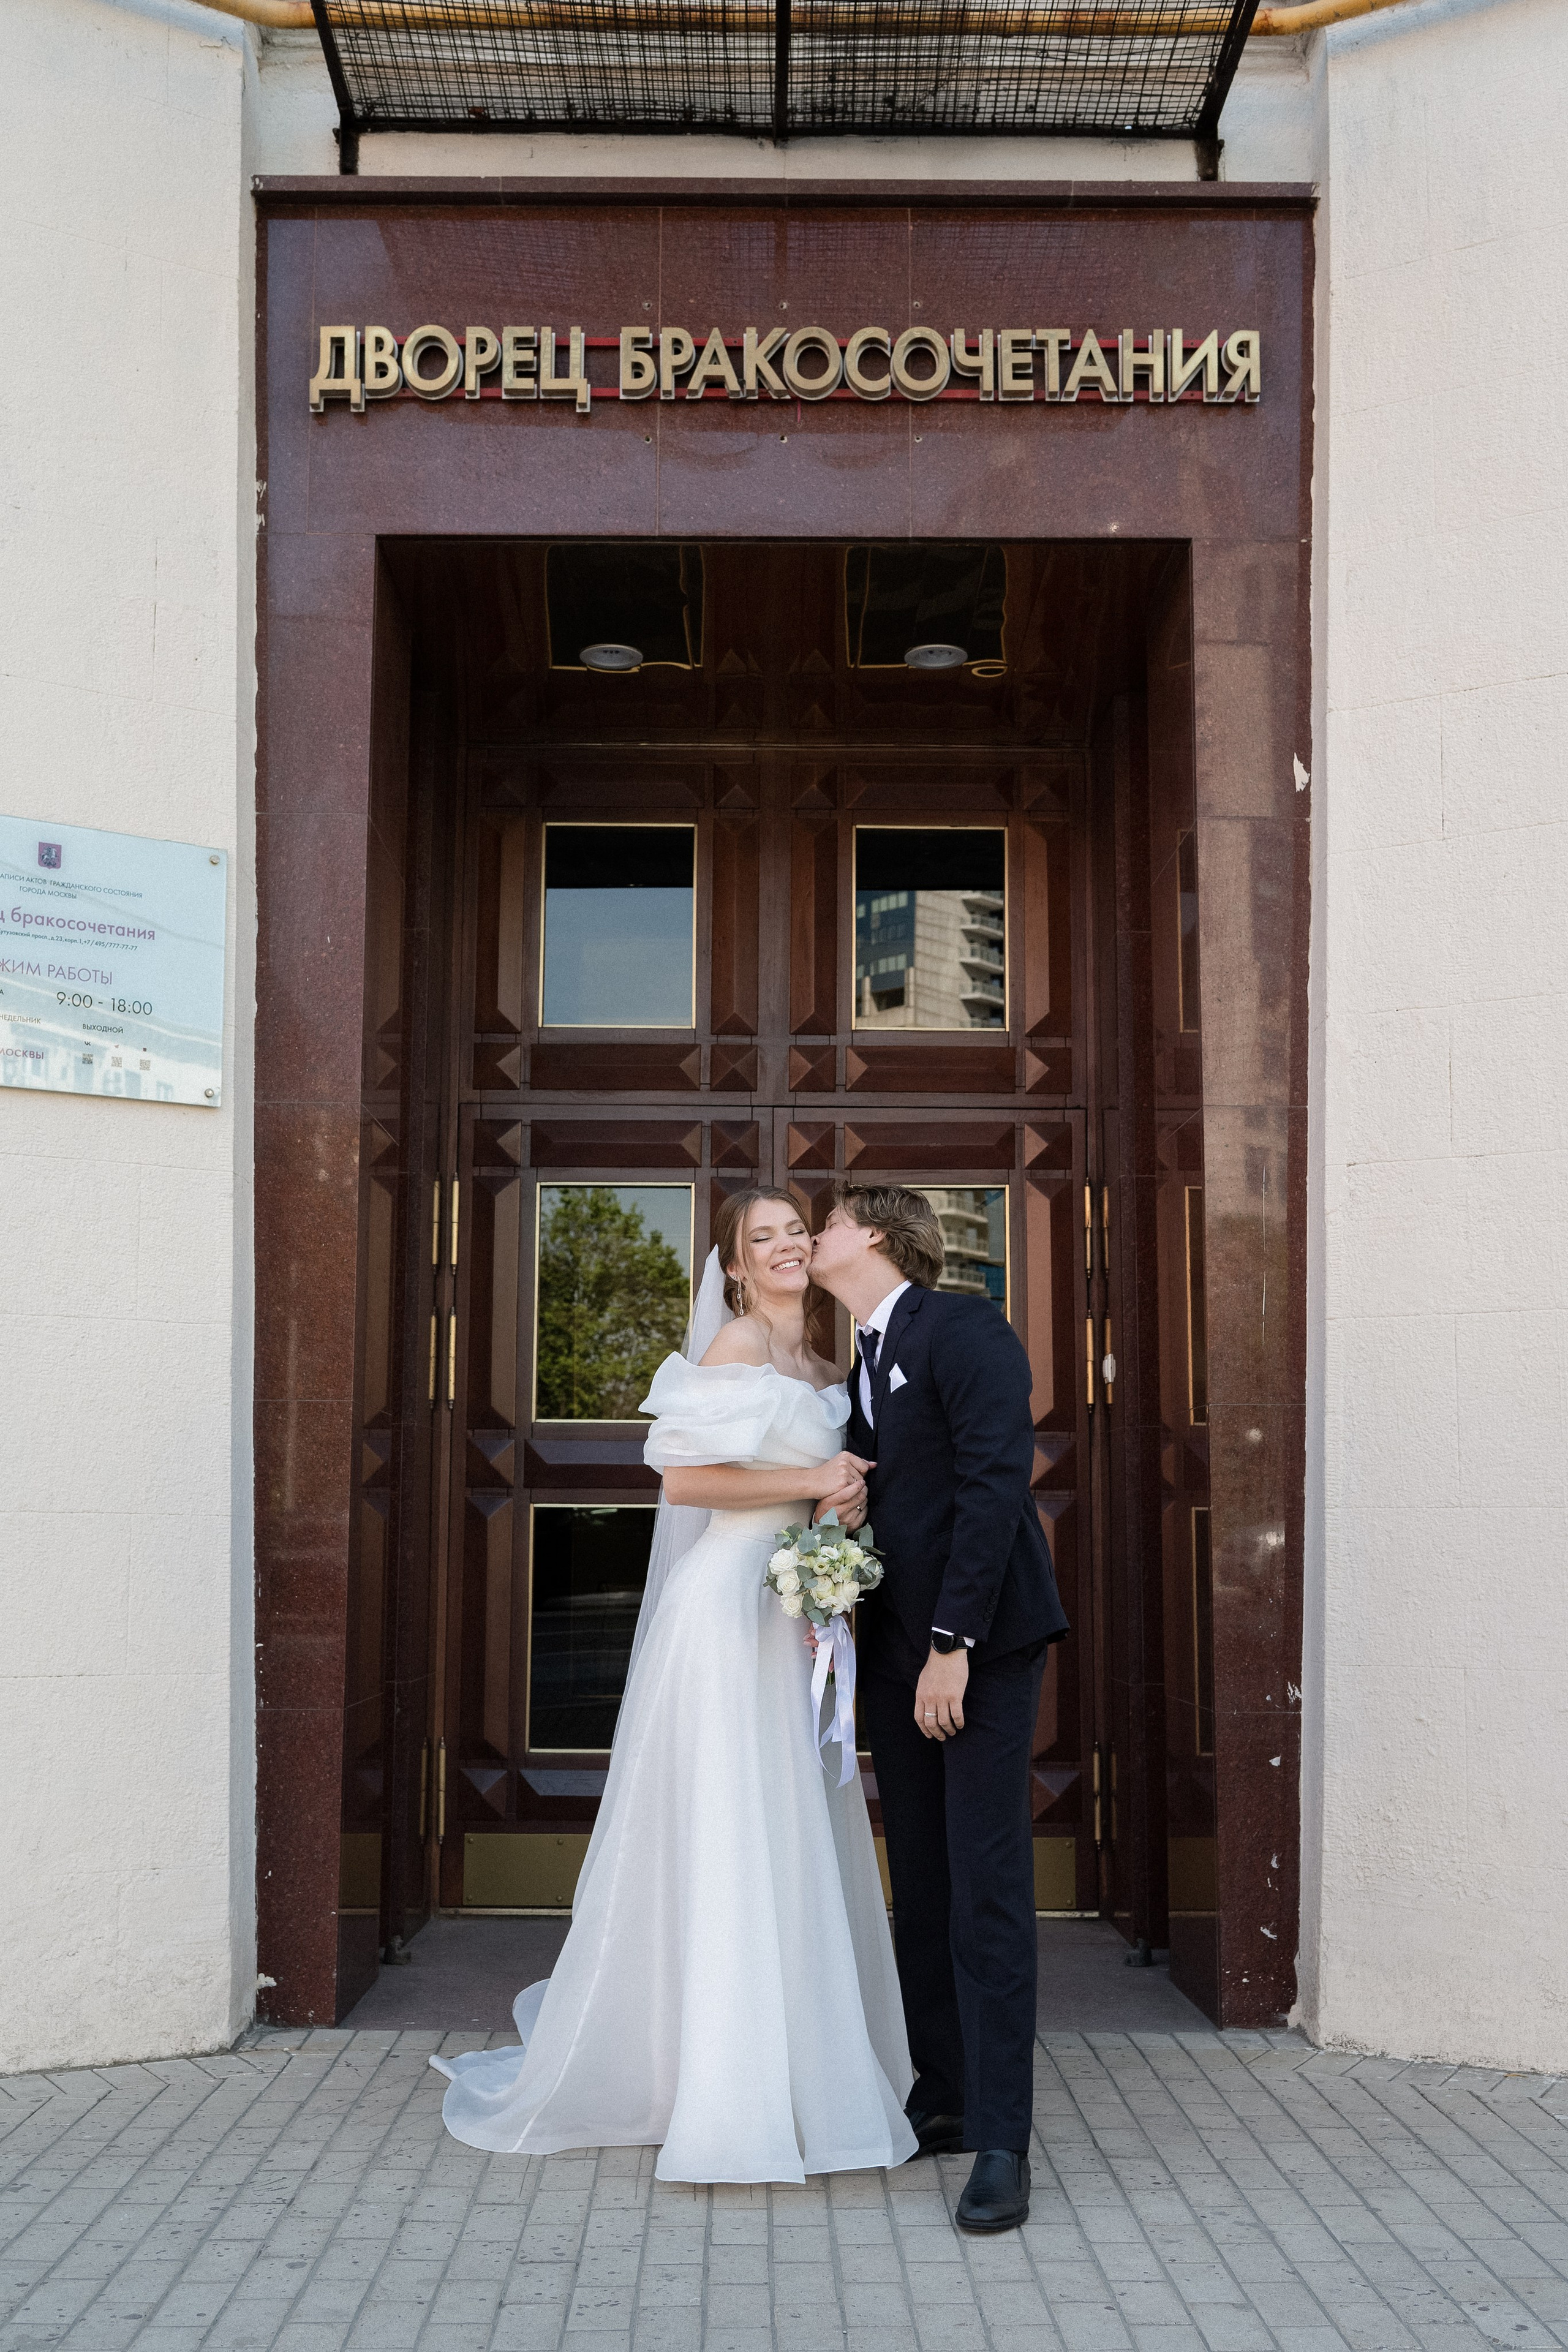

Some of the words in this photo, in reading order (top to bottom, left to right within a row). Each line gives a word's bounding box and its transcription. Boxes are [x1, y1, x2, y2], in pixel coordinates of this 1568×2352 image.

[309, 325, 591, 412] ДВОРЕЦ
[619, 326, 1261, 402] БРАКОСОЧЕТАНИЯ
[20, 886, 47, 895] ГОРОДА
[48, 890, 77, 899] МОСКВЫ
[50, 880, 102, 892] ГРАЖДАНСКОГО
[103, 888, 143, 899] СОСТОЯНИЯ
[11, 907, 156, 940] бракосочетания
[48, 964, 112, 985] РАБОТЫ
[56, 992, 92, 1008] 9:00
[111, 998, 153, 1015] 18:00
[82, 1023, 124, 1033] ВЫХОДНОЙ
